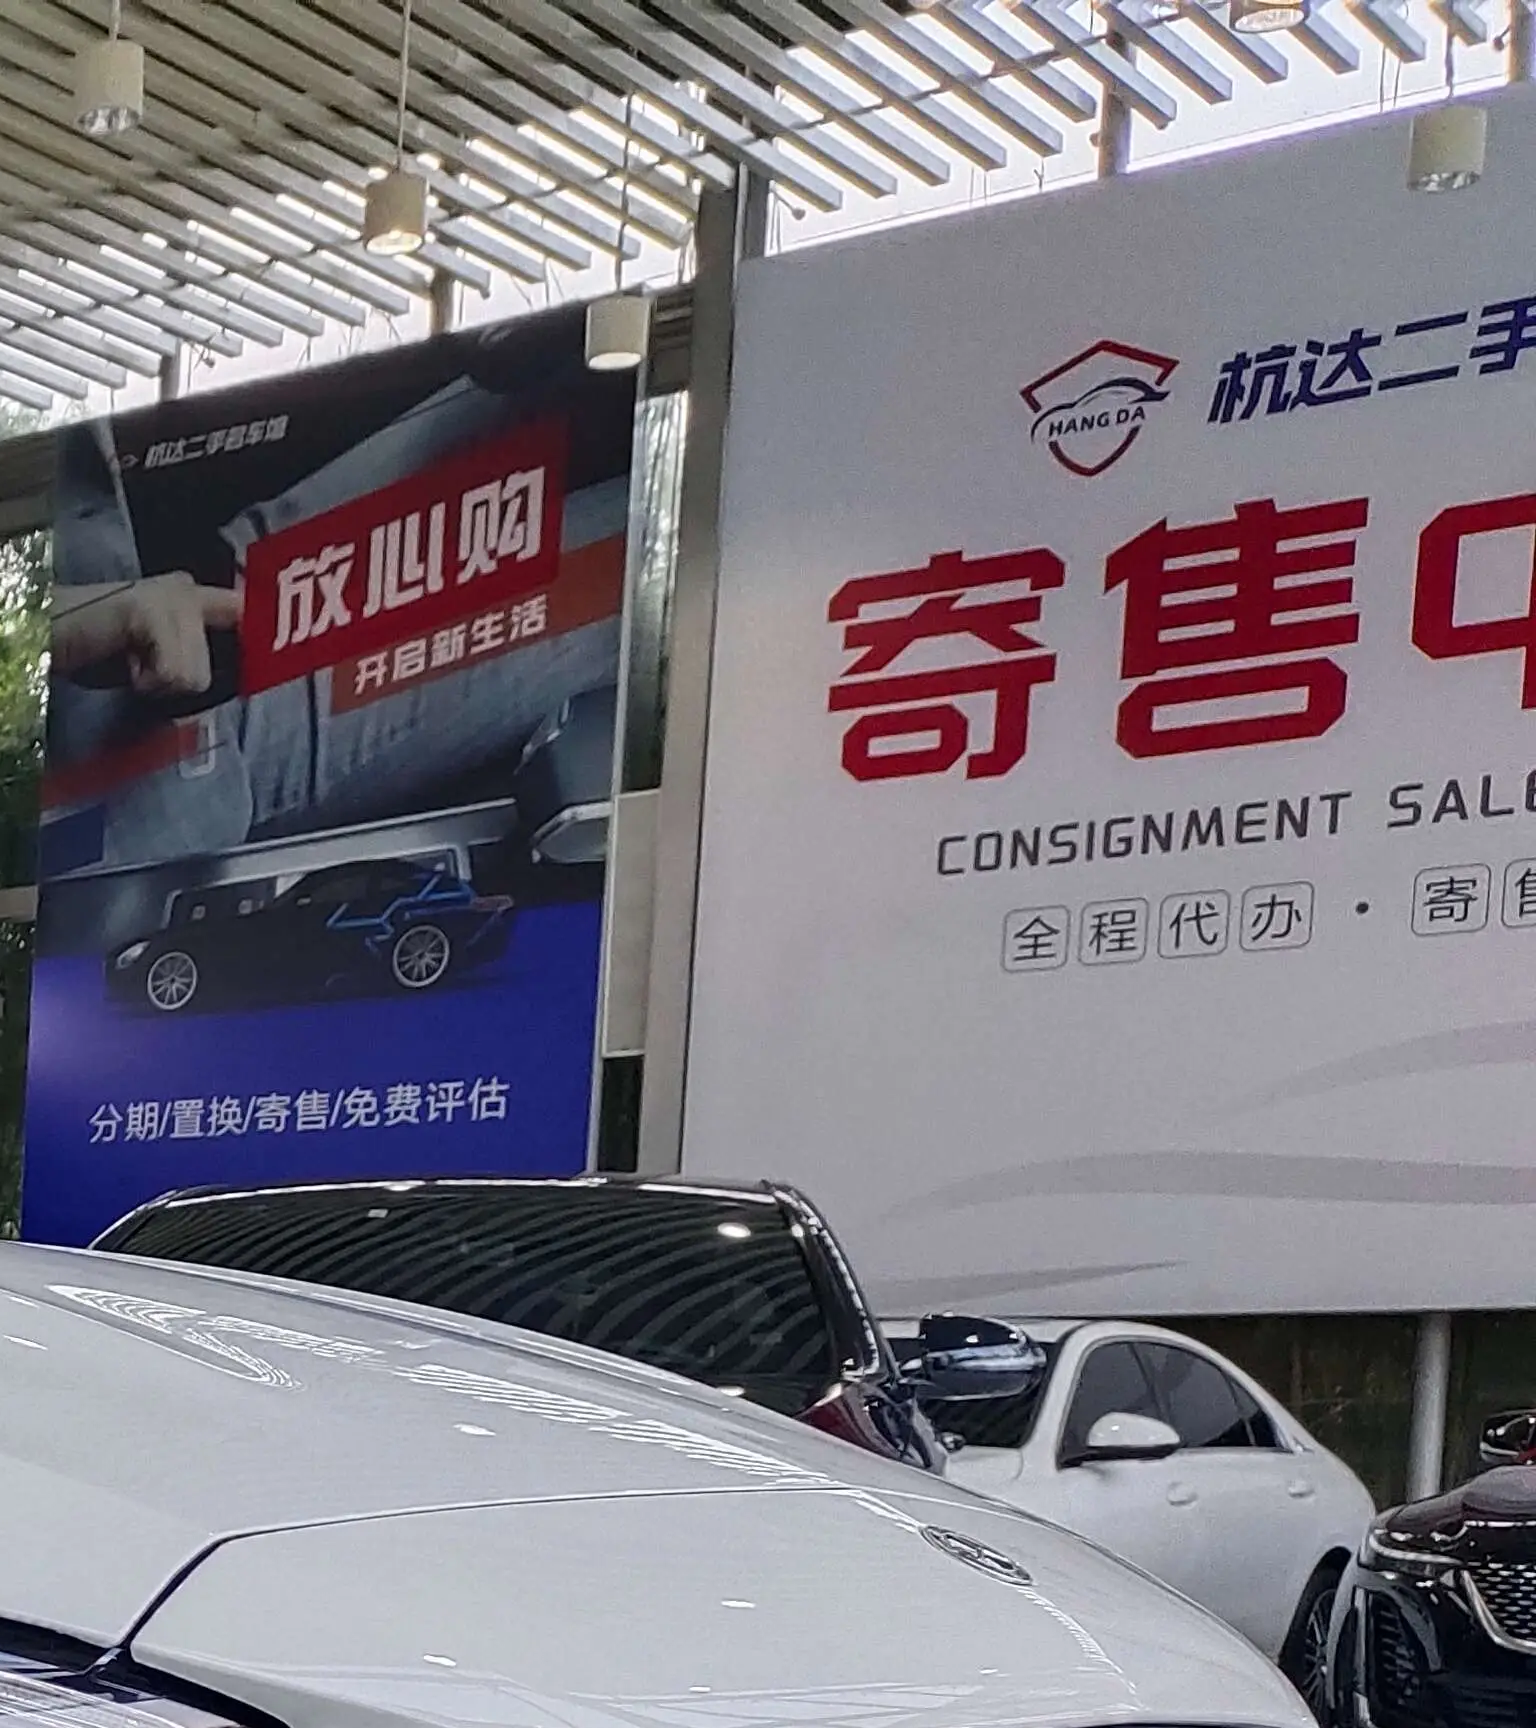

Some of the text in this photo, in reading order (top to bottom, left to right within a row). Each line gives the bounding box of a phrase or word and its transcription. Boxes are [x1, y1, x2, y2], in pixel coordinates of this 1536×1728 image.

[1048, 405, 1146, 438] HANG DA
[273, 465, 546, 651] 放心购
[354, 593, 548, 695] 开启新生活
[936, 791, 1352, 876] CONSIGNMENT
[1012, 894, 1303, 962] 全程代办
[88, 1076, 510, 1144] 分期/置换/寄售/免费评估
